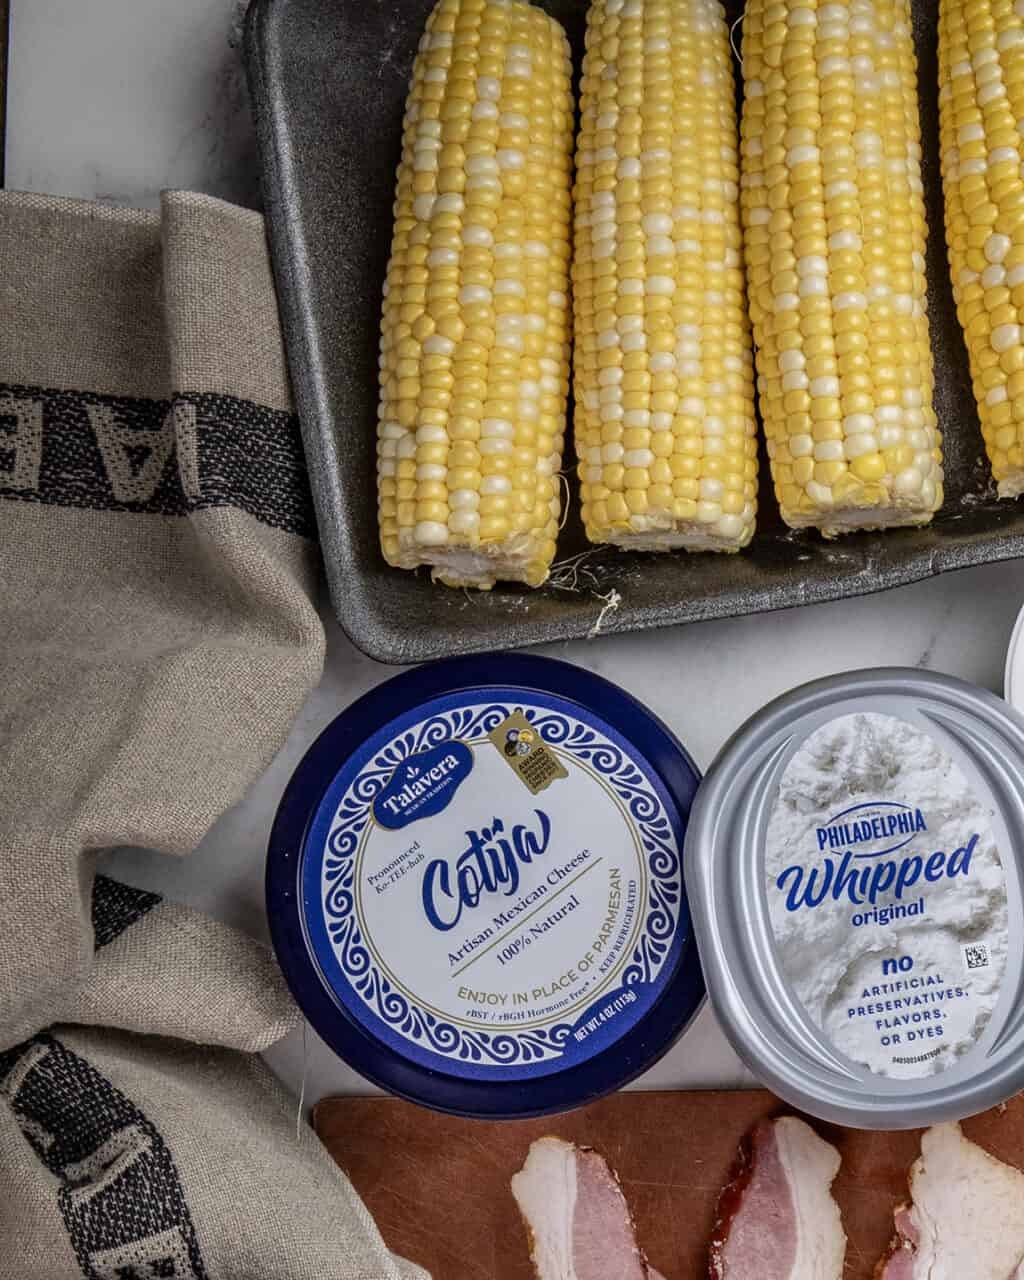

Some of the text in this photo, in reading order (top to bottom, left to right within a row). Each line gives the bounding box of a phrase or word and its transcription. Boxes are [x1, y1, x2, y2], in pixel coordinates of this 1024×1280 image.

[383, 754, 460, 815] Talavera
[816, 808, 928, 851] PHILADELPHIA
[367, 841, 421, 885] Pronounced
[422, 809, 551, 932] Cotija
[776, 833, 980, 912] Whipped
[448, 847, 592, 966] Artisan Mexican Cheese
[599, 879, 637, 974] KEEP REFRIGERATED
[852, 897, 925, 928] original
[457, 867, 622, 1006] ENJOY IN PLACE OF PARMESAN
[496, 895, 580, 966] 100% Natural
[862, 974, 944, 998] ARTIFICIAL
[882, 955, 913, 975] no
[528, 998, 569, 1018] Hormone
[848, 987, 969, 1018] PRESERVATIVES,
[880, 1025, 944, 1046] OR DYES
